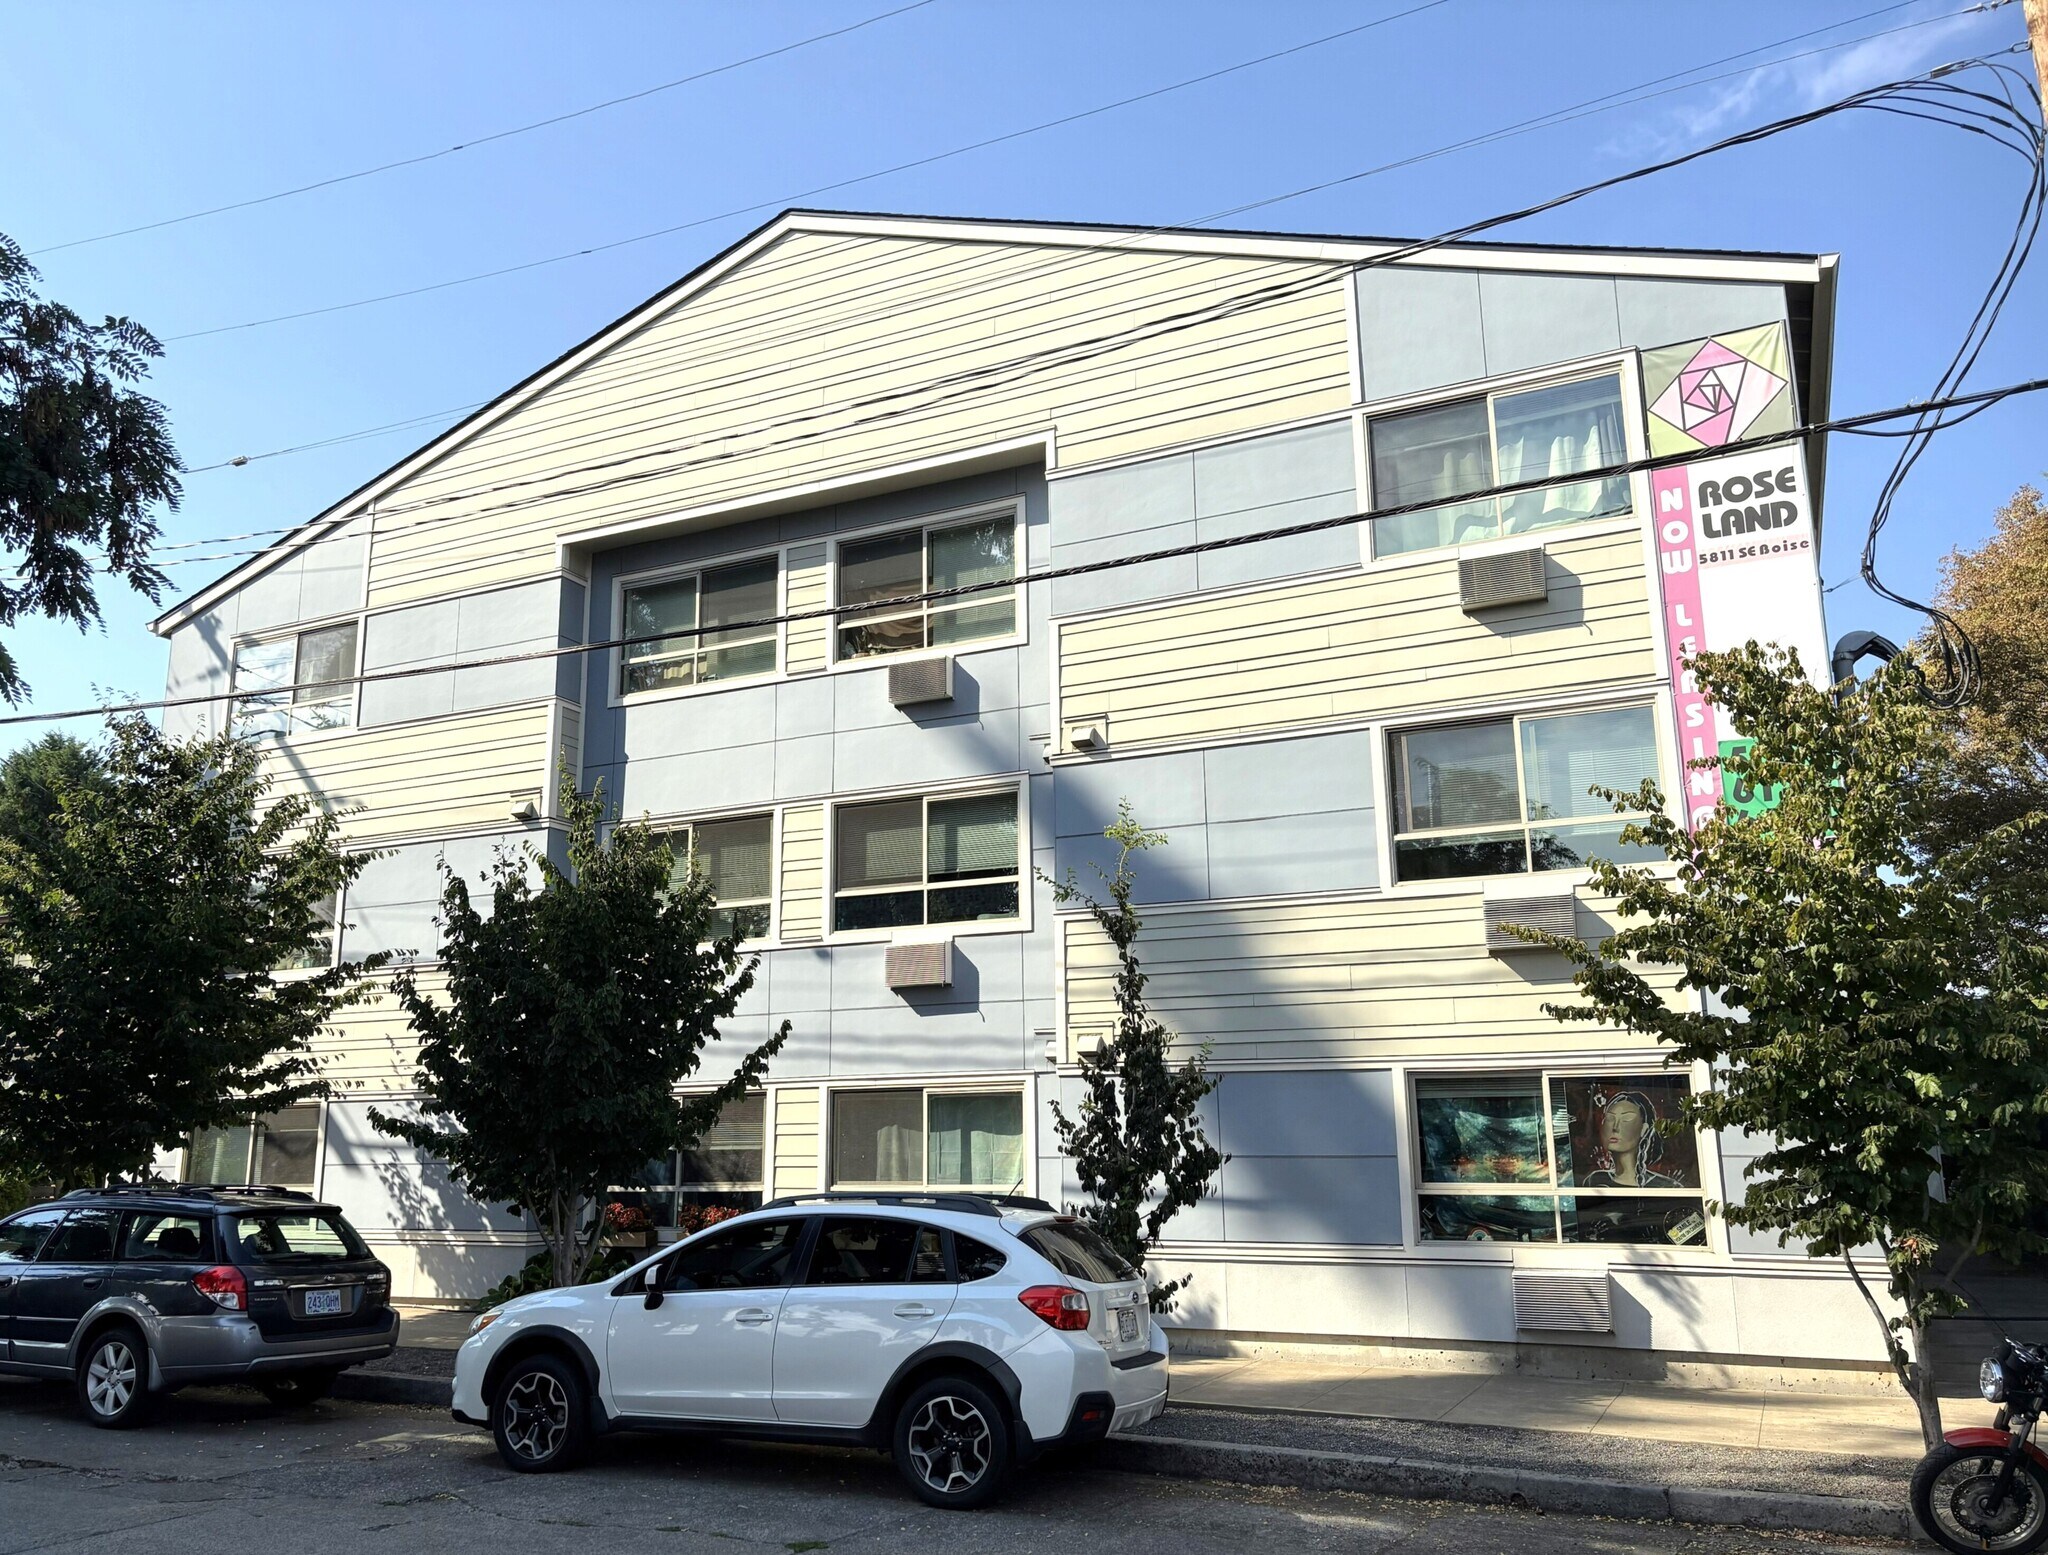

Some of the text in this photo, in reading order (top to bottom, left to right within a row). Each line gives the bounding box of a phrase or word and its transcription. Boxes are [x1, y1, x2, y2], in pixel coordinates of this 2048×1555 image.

[1699, 466, 1796, 508] ROSE
[1660, 487, 1692, 574] NOW
[1702, 500, 1798, 539] LAND
[1699, 540, 1810, 564] 5811 SE Boise
